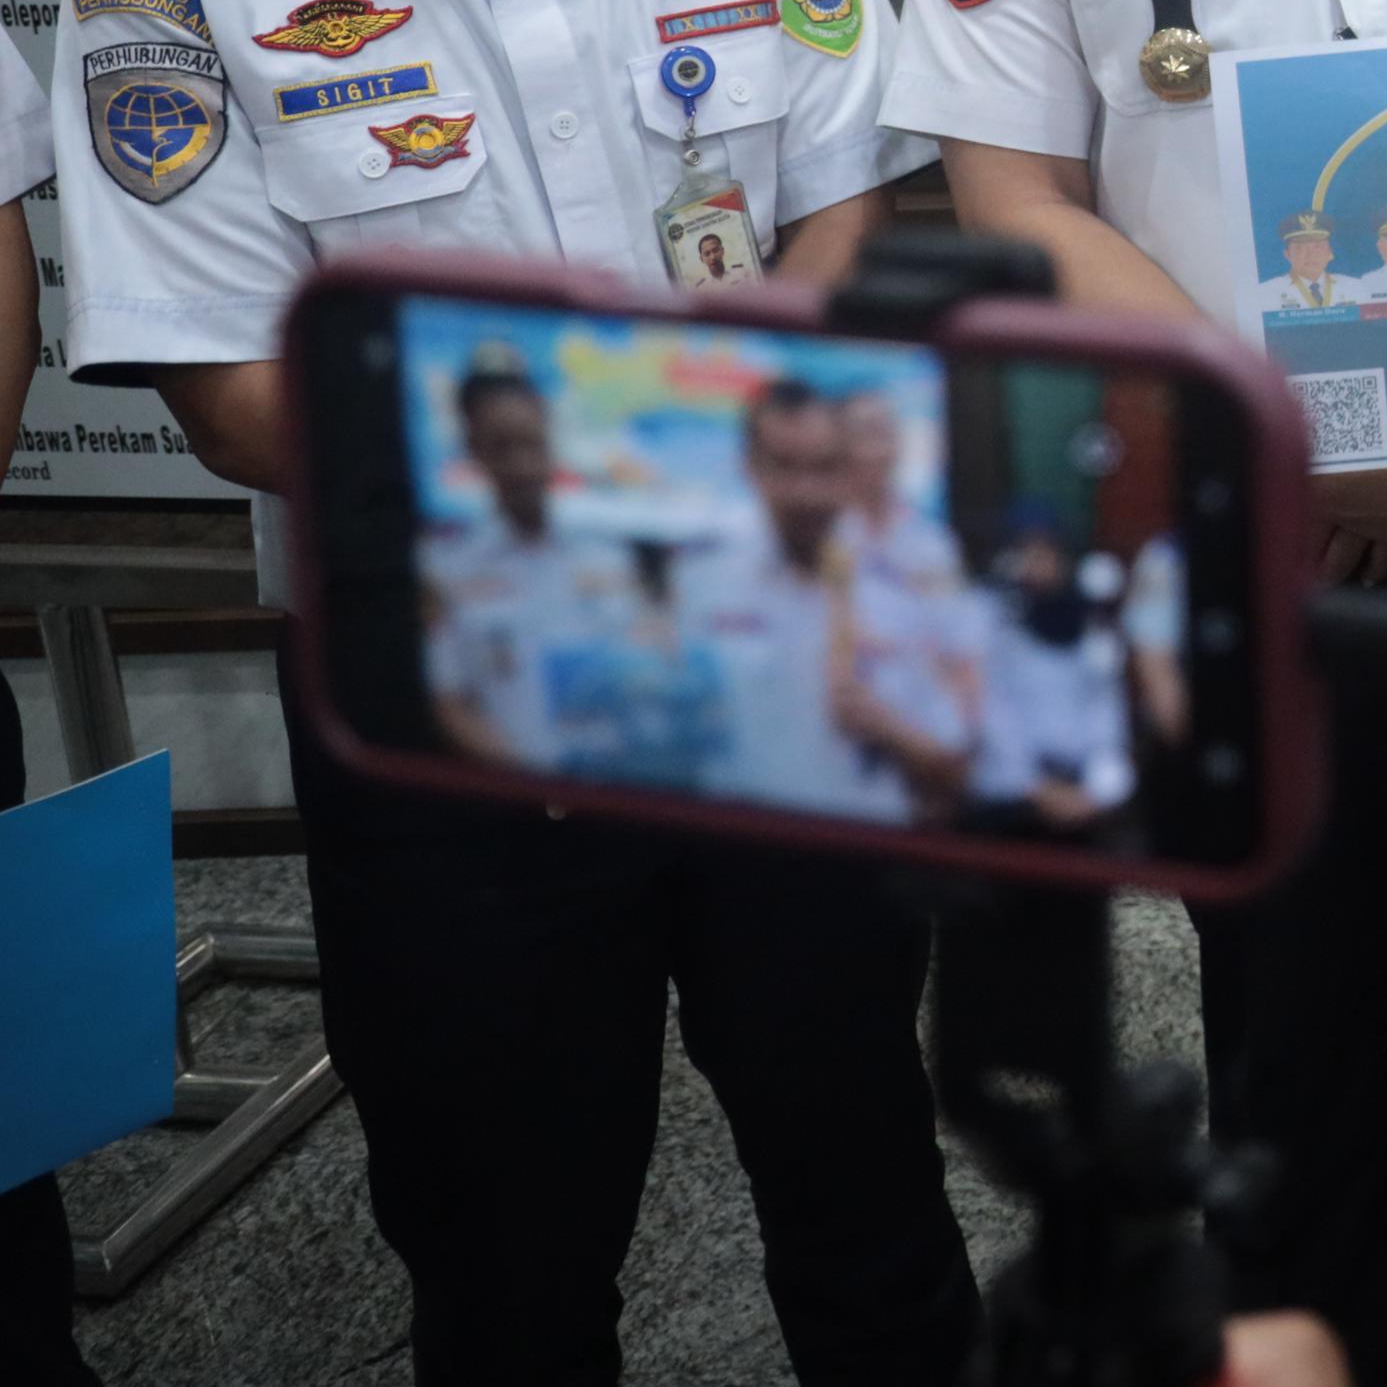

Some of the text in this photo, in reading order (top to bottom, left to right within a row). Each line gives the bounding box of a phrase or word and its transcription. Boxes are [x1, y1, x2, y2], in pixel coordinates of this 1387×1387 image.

[89, 44, 219, 75] PERHUBUNGAN
[316, 77, 394, 108] SIGIT
[75, 424, 158, 454] Perekam
